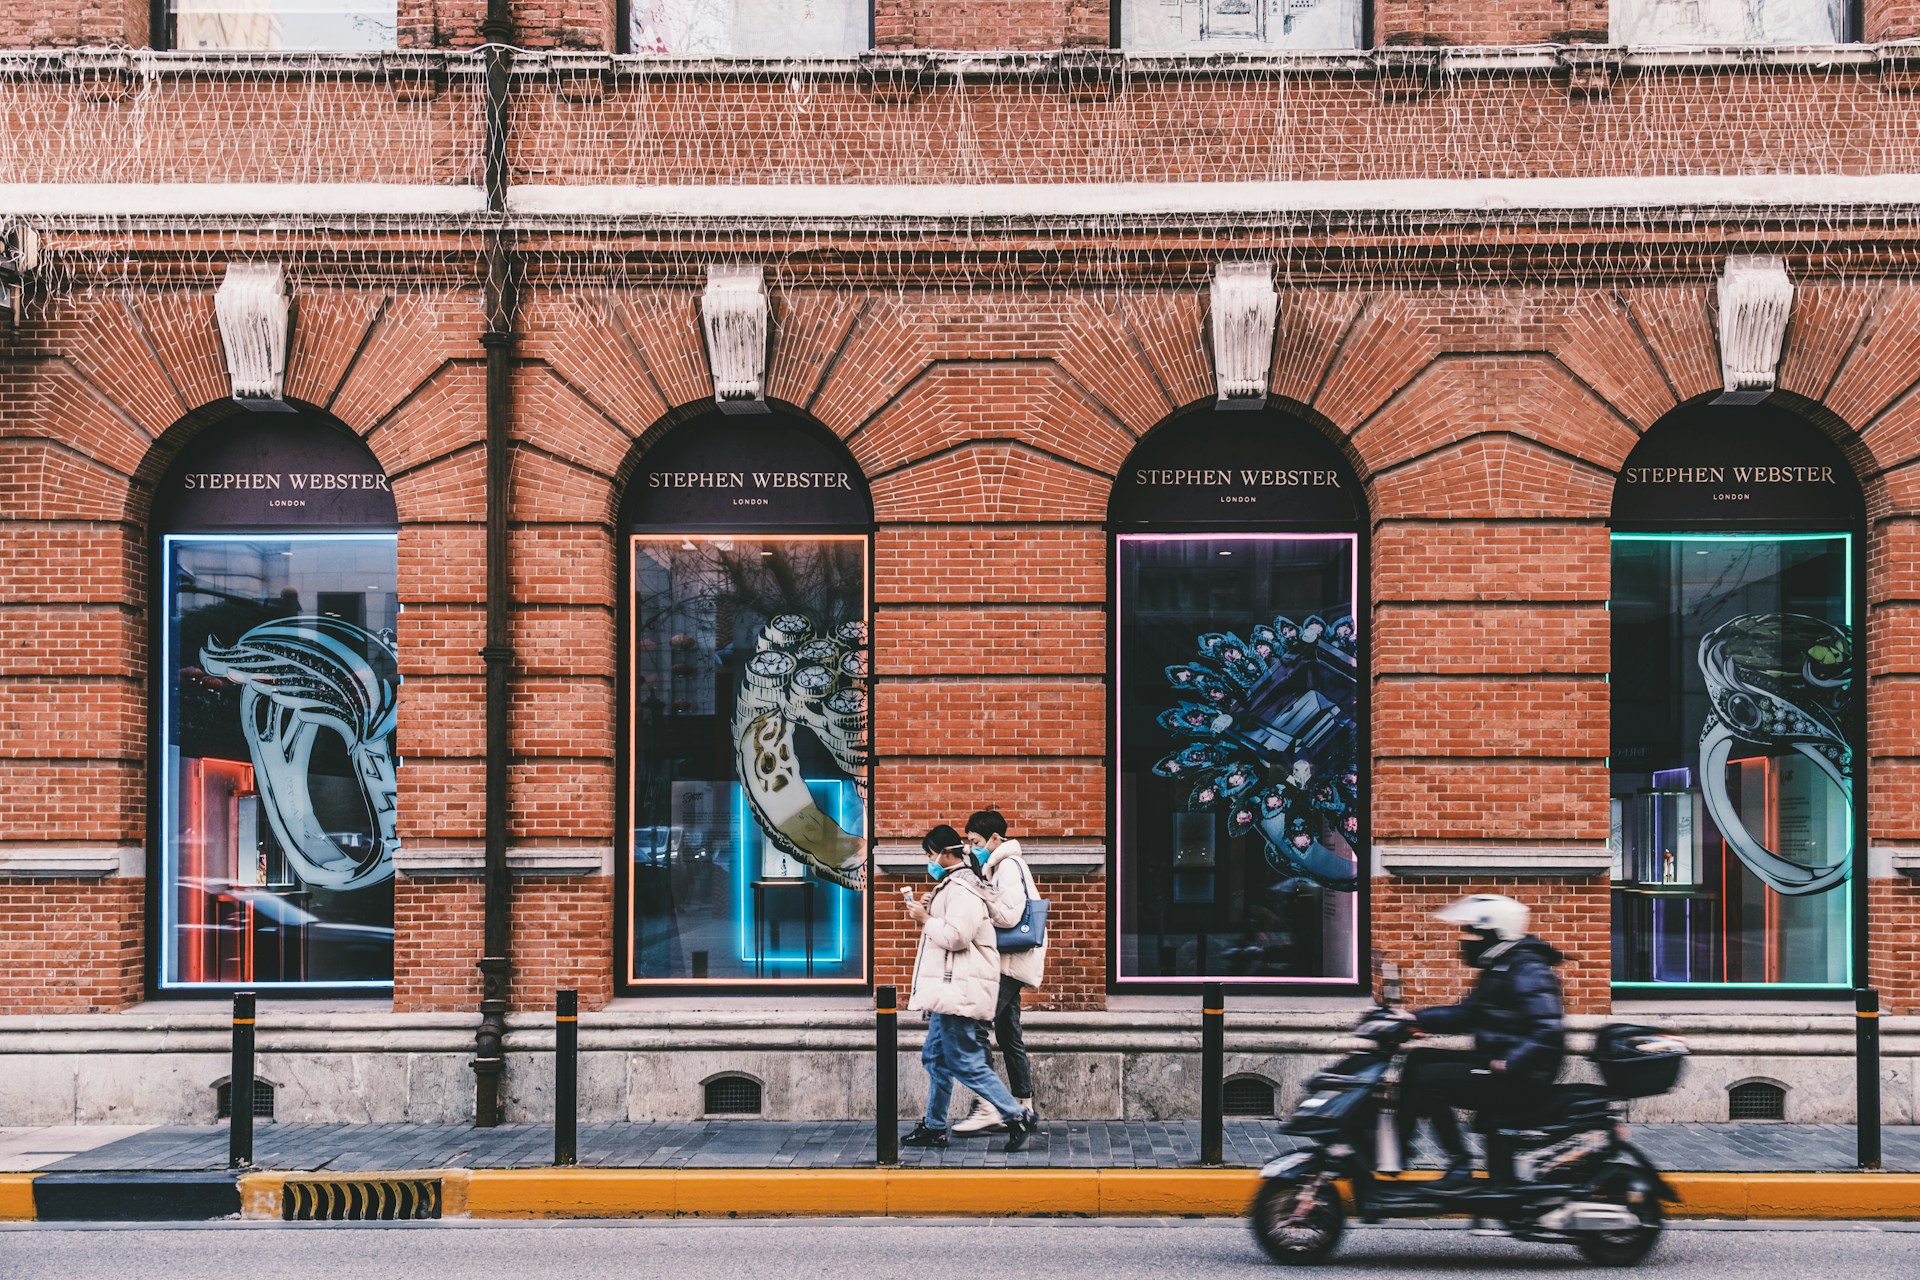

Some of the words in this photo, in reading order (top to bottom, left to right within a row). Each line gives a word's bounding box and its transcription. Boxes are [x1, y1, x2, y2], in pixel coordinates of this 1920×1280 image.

[184, 473, 281, 489] STEPHEN
[289, 473, 390, 491] WEBSTER
[649, 472, 743, 488] STEPHEN
[752, 472, 851, 490] WEBSTER
[1136, 469, 1231, 485] STEPHEN
[1241, 470, 1340, 487] WEBSTER
[1626, 466, 1724, 483] STEPHEN
[1733, 466, 1835, 483] WEBSTER
[269, 499, 305, 507] LONDON
[733, 498, 768, 506] LONDON
[1713, 493, 1749, 501] LONDON
